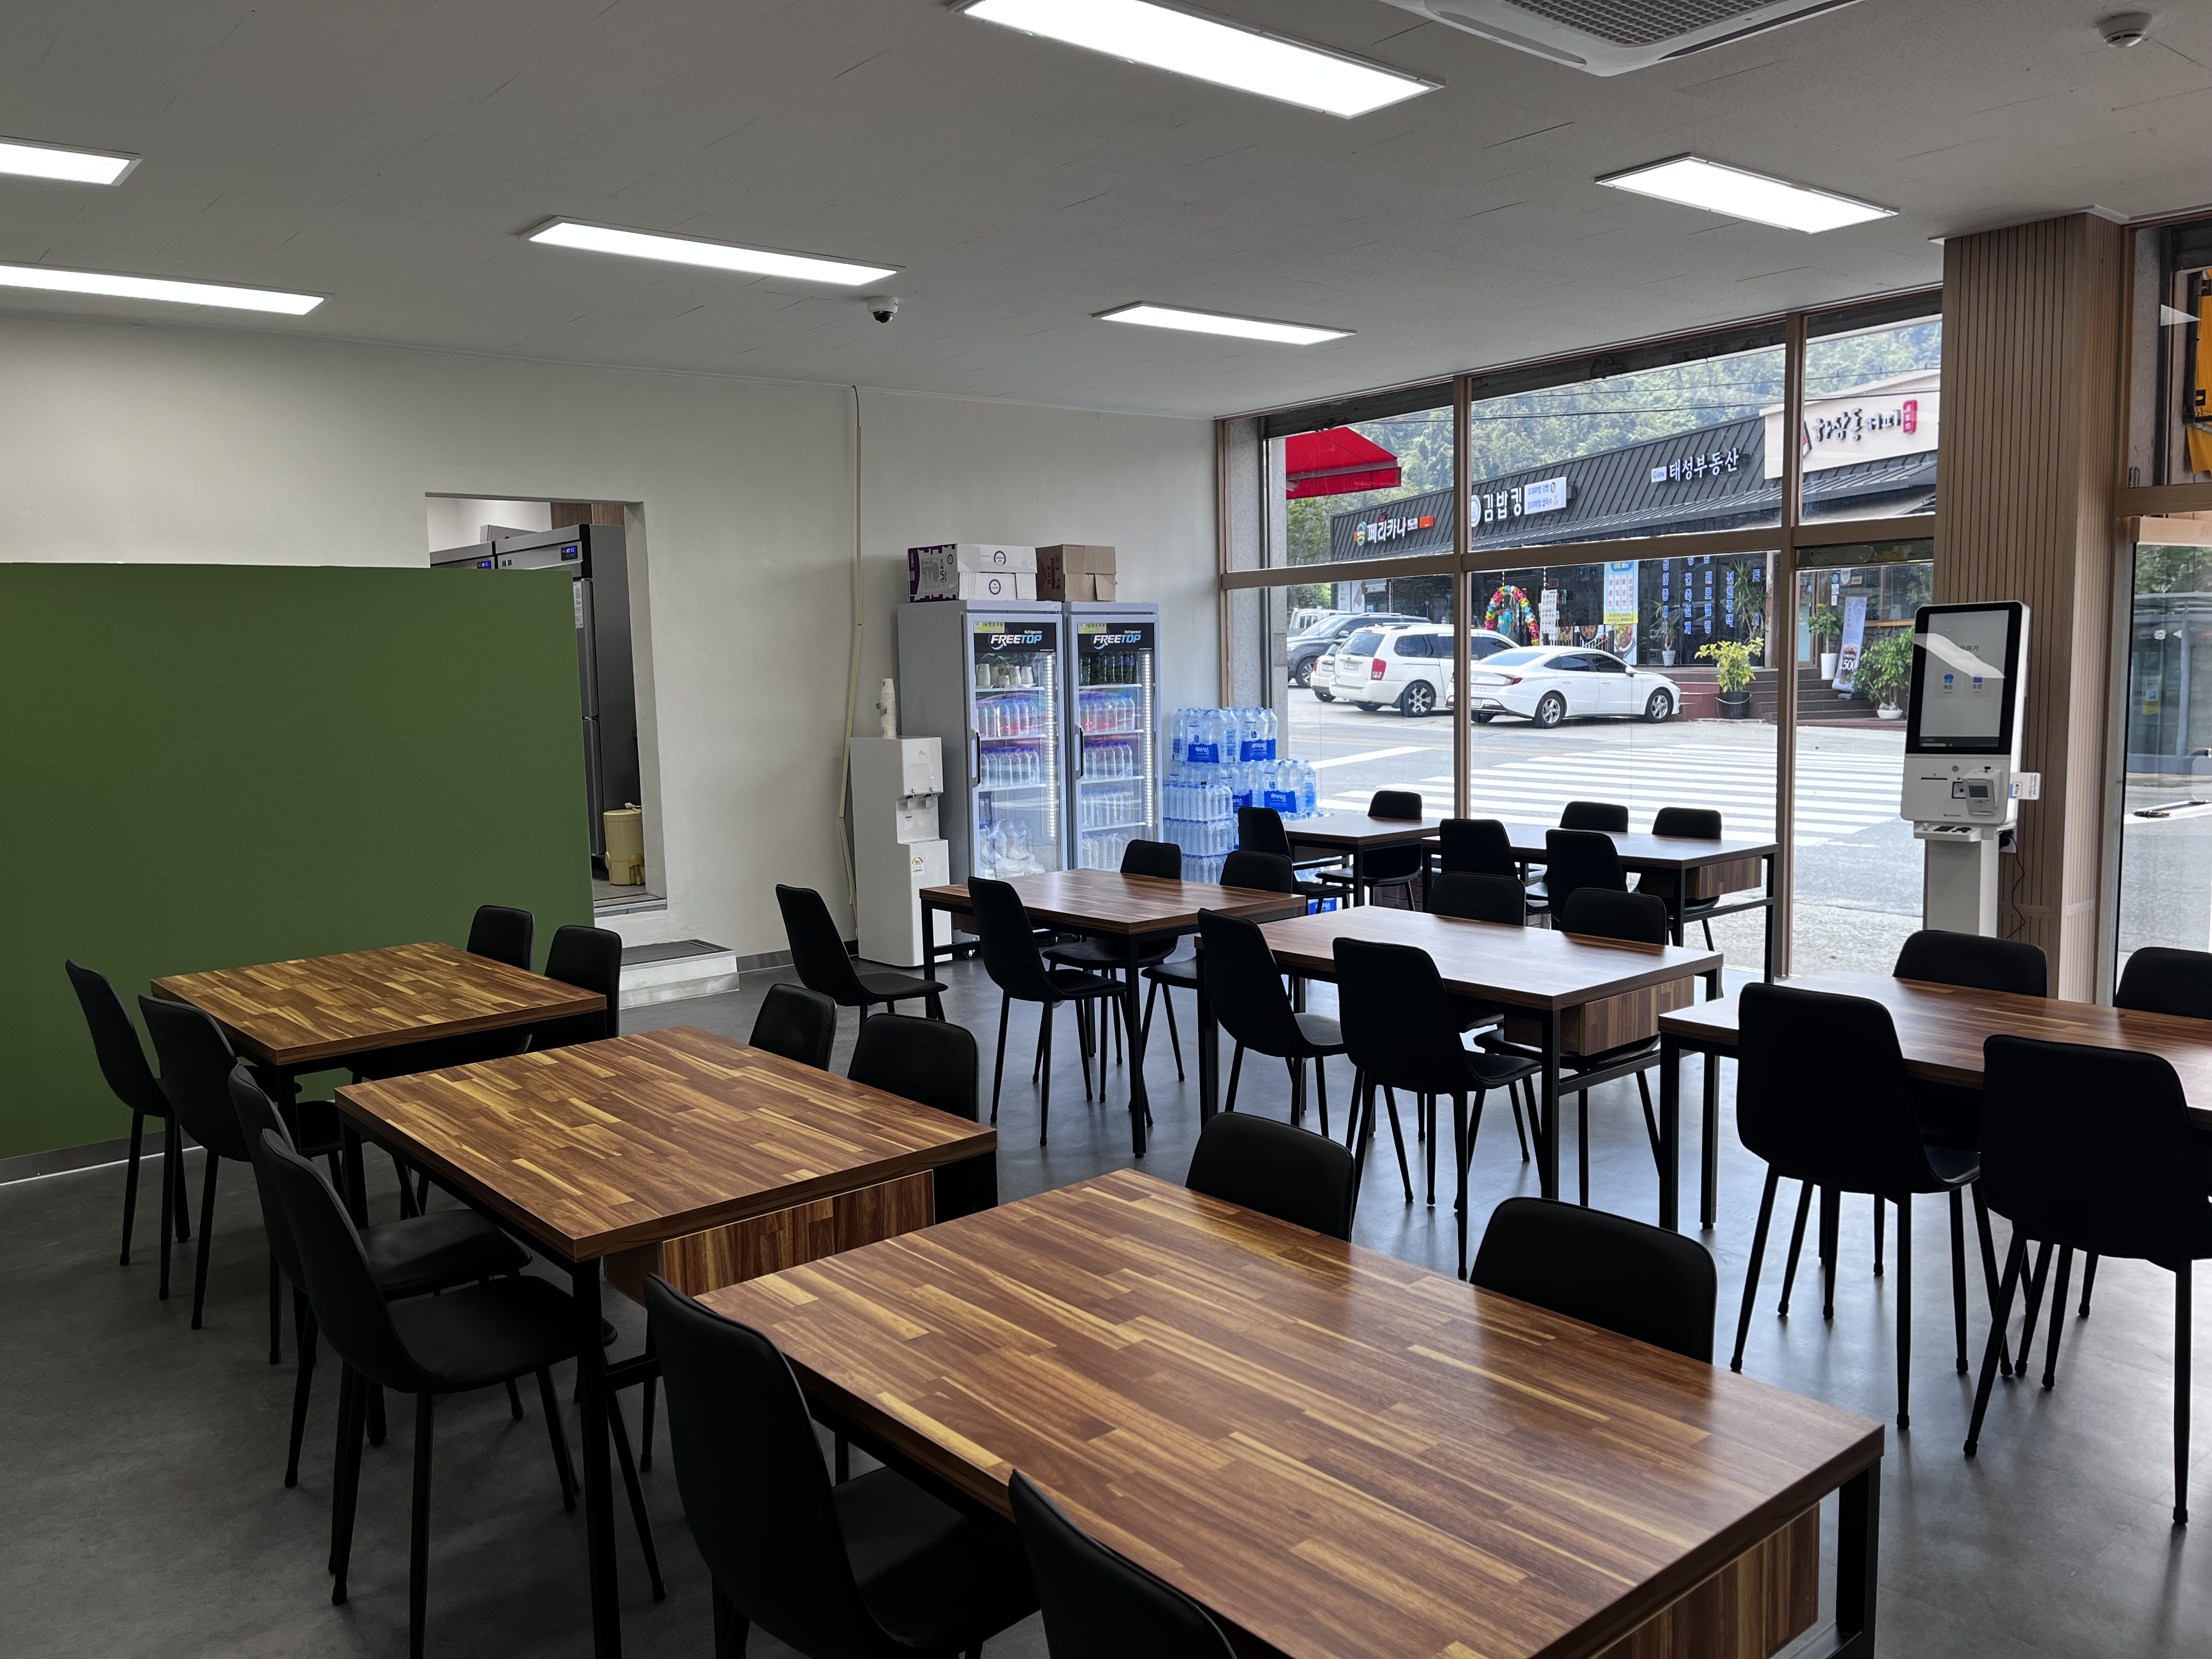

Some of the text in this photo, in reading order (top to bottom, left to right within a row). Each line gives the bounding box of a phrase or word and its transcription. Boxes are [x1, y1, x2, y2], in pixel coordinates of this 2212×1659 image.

[1865, 410, 1901, 430] 커피
[1669, 447, 1739, 481] 태성부동산
[1652, 471, 1665, 479] Glow
[1542, 484, 1550, 493] 김밥
[1483, 487, 1522, 522] 김밥킹
[1367, 516, 1407, 543] 페리카나
[1704, 571, 1712, 634] 리모델링
[990, 634, 1042, 646] FREETOP
[1093, 634, 1142, 646] FREETOP
